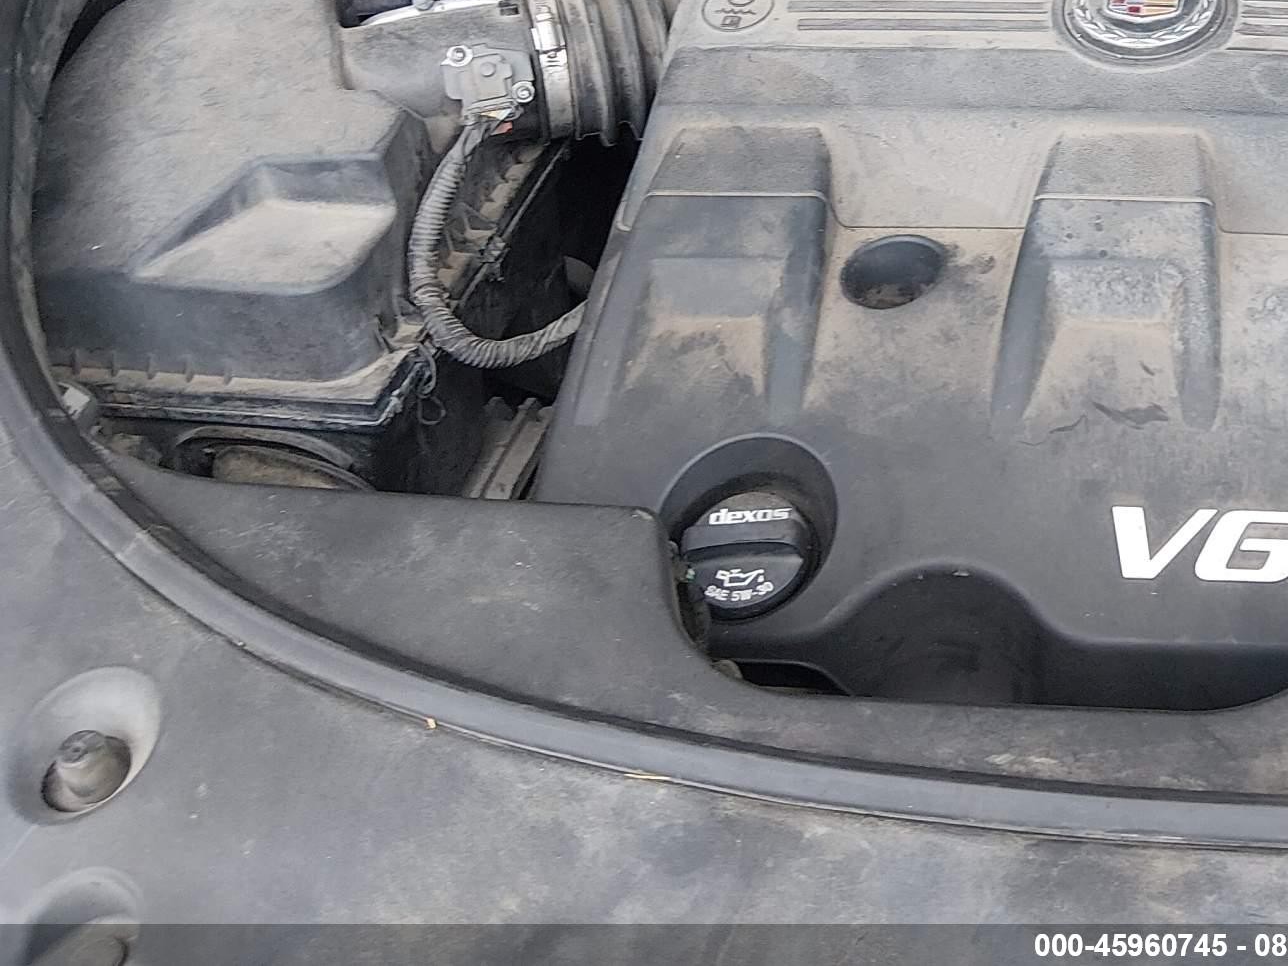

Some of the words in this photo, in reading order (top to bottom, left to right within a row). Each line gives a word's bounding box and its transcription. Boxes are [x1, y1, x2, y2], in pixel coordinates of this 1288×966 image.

[708, 507, 793, 525] dexos
[704, 585, 731, 601] SAE
[730, 581, 775, 602] 5W-30
